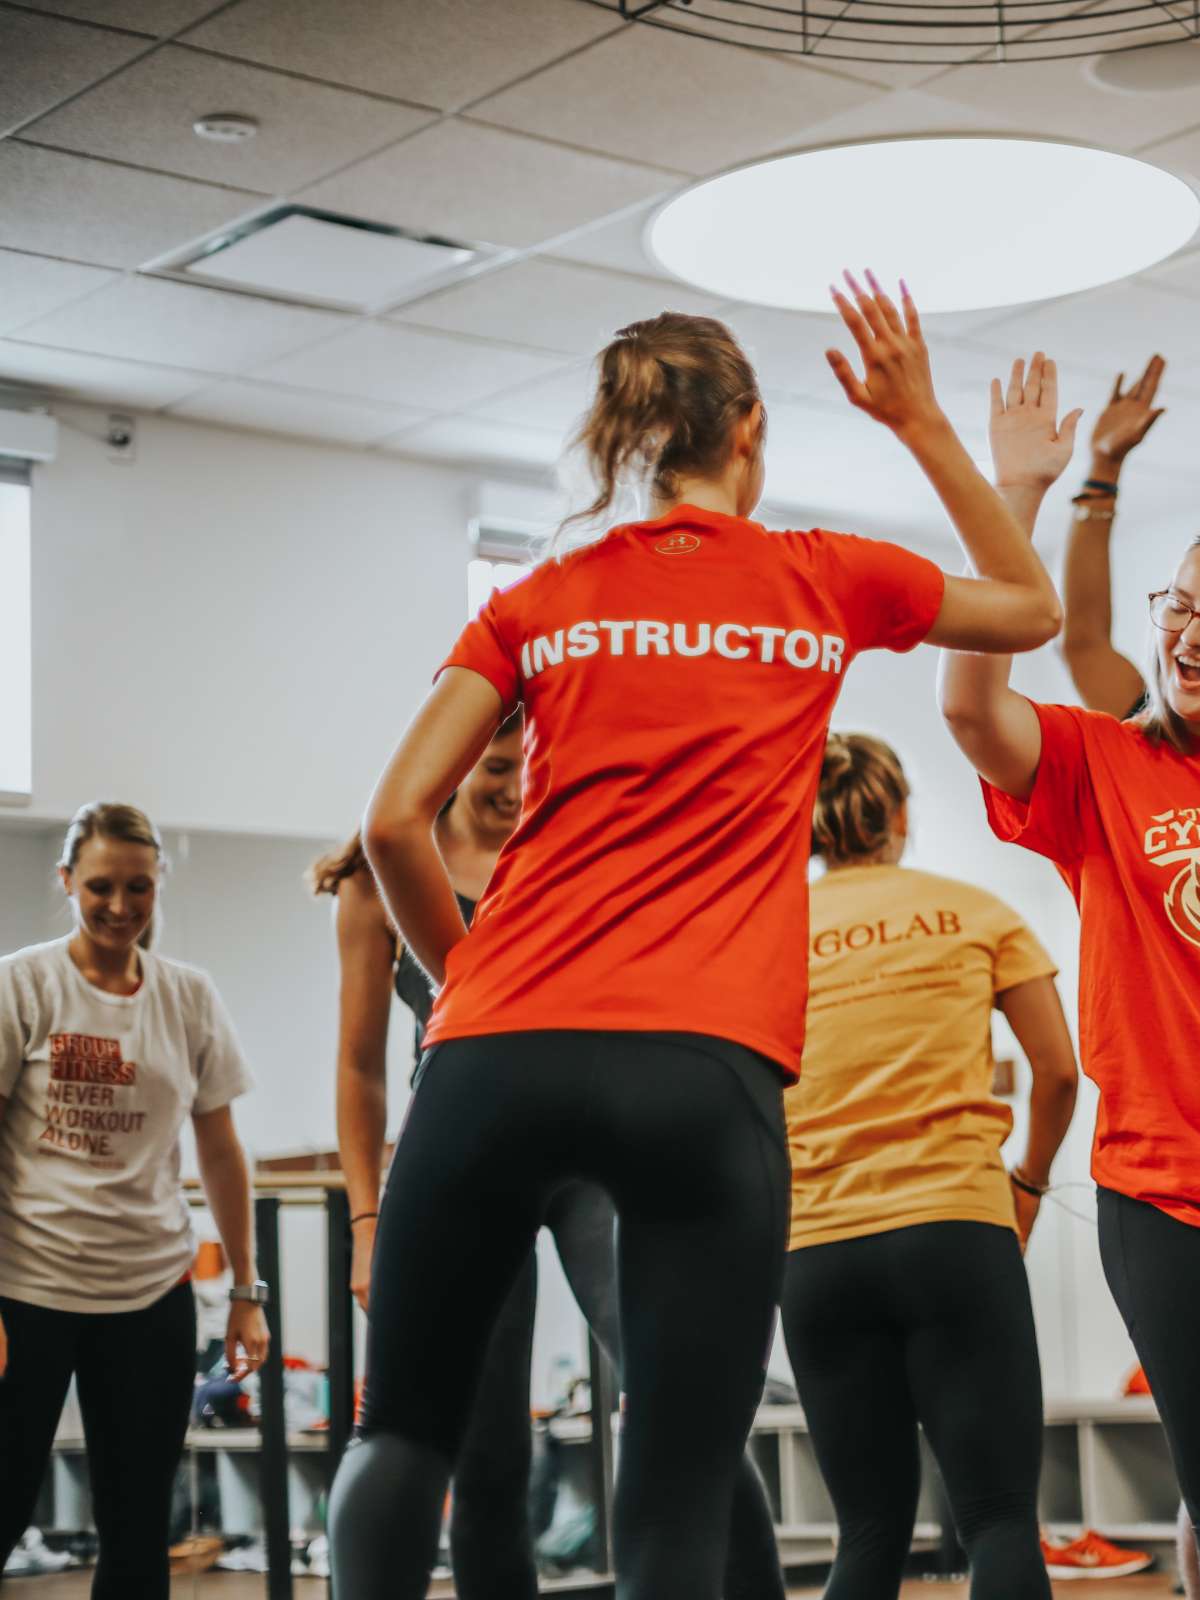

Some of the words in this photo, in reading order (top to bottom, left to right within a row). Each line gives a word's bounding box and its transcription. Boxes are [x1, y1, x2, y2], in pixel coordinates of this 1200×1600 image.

[521, 620, 845, 679] INSTRUCTOR
[51, 1036, 119, 1058] GROUP
[47, 1082, 114, 1106] NEVER
[44, 1105, 146, 1132] WORKOUT
[40, 1125, 114, 1156] ALONE
